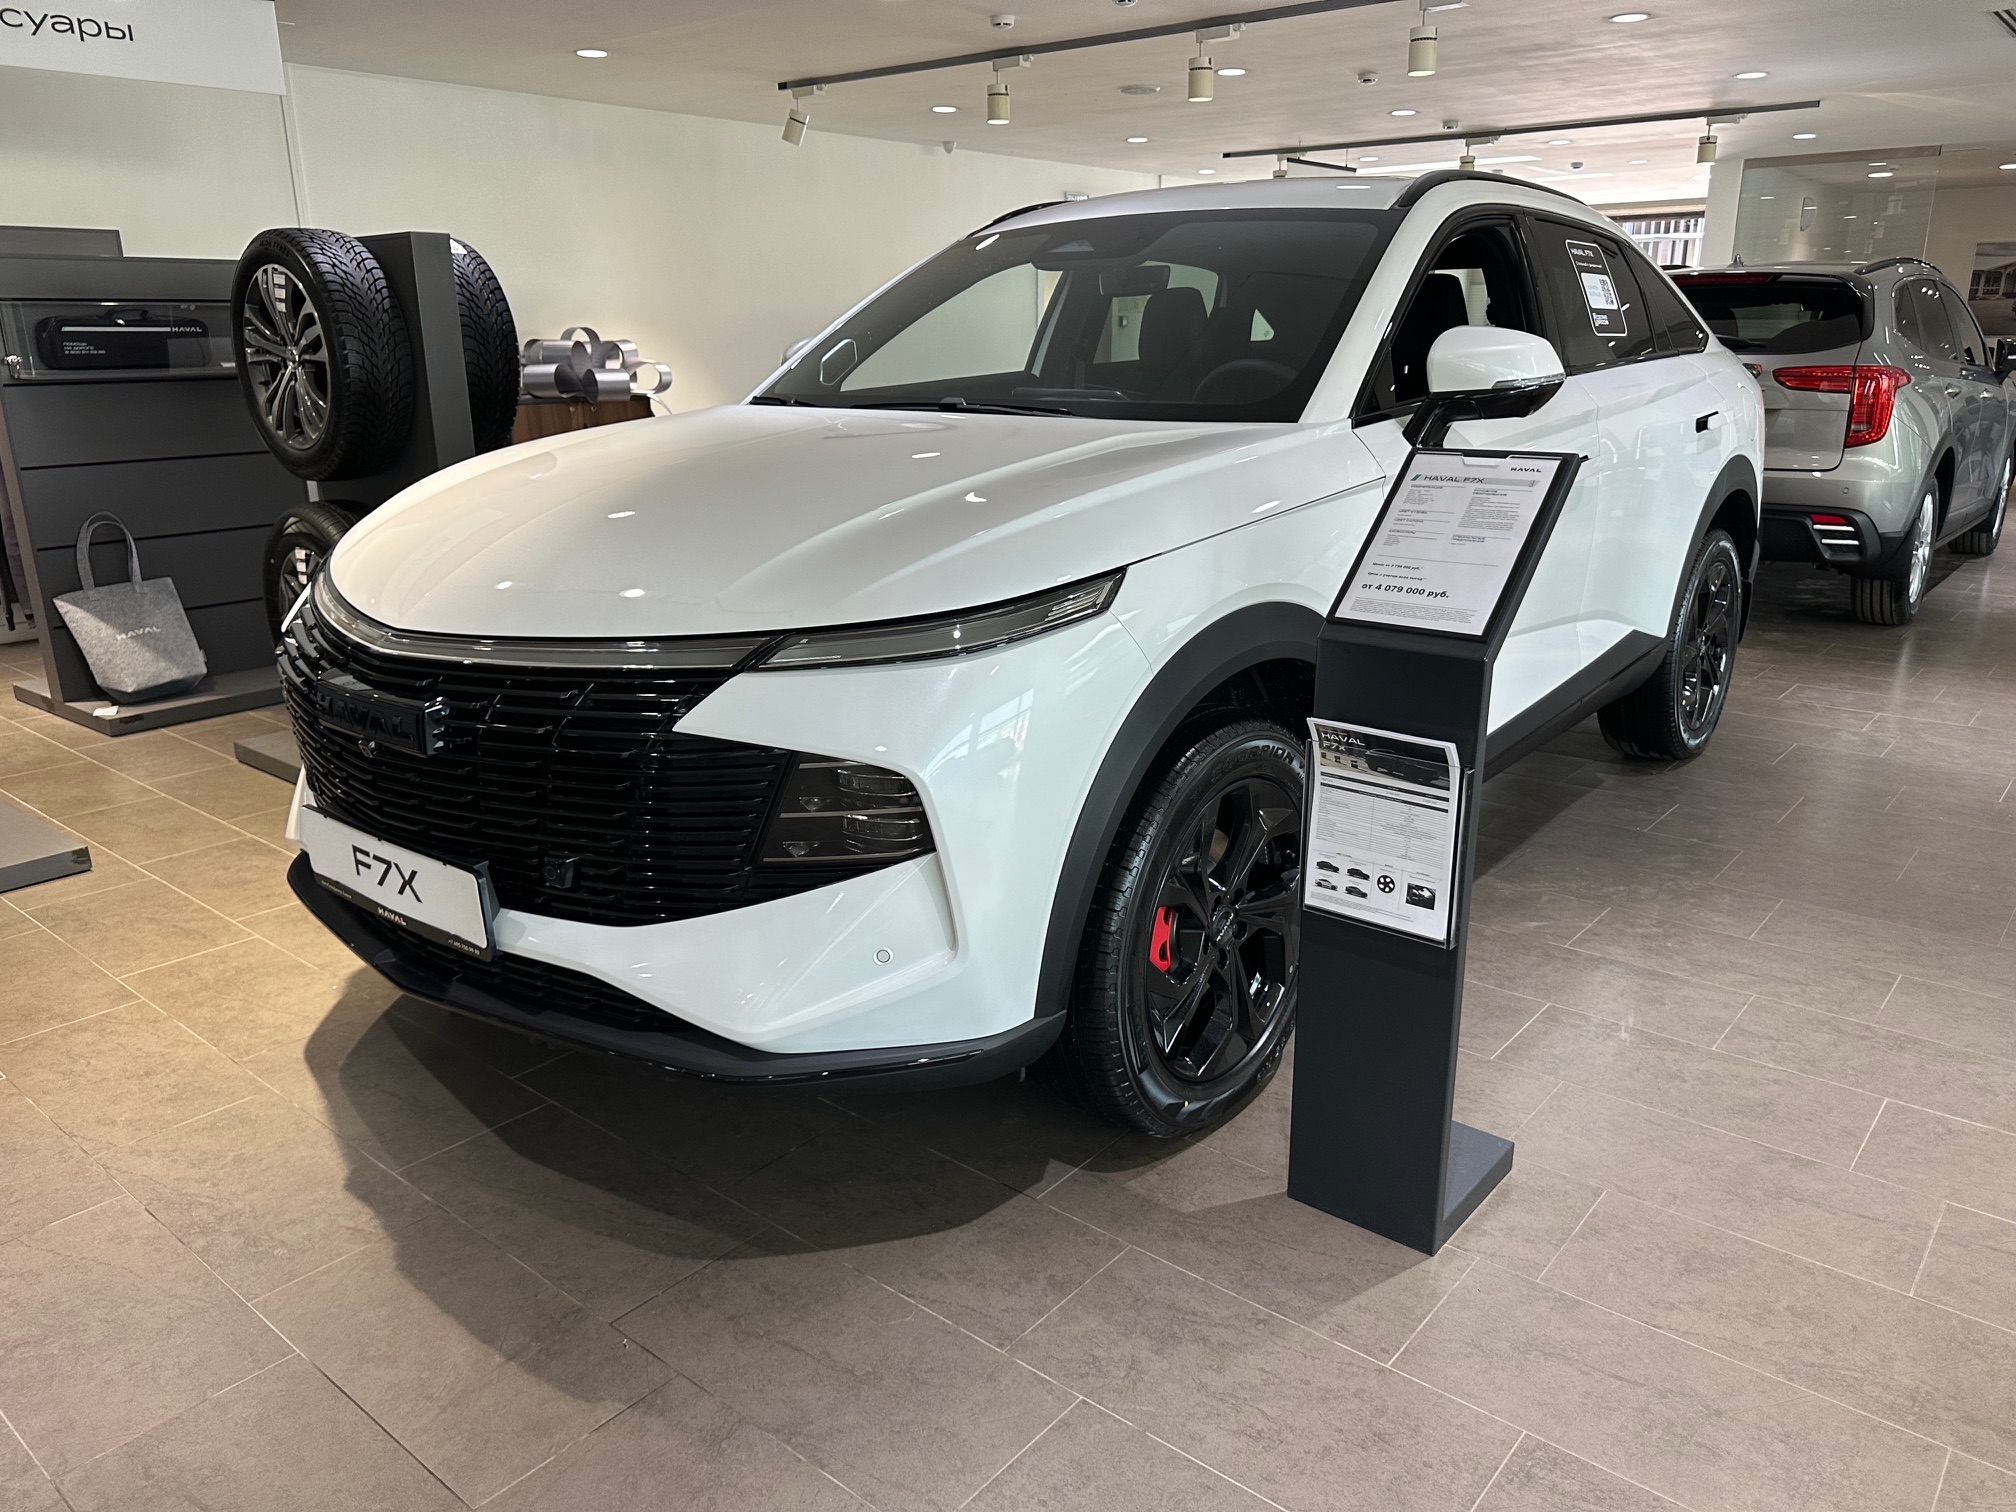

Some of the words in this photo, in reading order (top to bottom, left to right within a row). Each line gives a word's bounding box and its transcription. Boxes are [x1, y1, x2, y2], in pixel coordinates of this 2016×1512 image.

[0, 7, 134, 42] суары
[1423, 475, 1460, 483] HAVAL
[1374, 583, 1382, 591] 4
[1384, 584, 1403, 593] 079
[1405, 587, 1425, 596] 000
[1426, 589, 1449, 599] руб.
[116, 626, 161, 640] HAVAL
[1321, 732, 1365, 746] HAVAL
[1323, 741, 1346, 751] F7X
[352, 844, 423, 904] F7X
[377, 906, 407, 926] HAVAL
